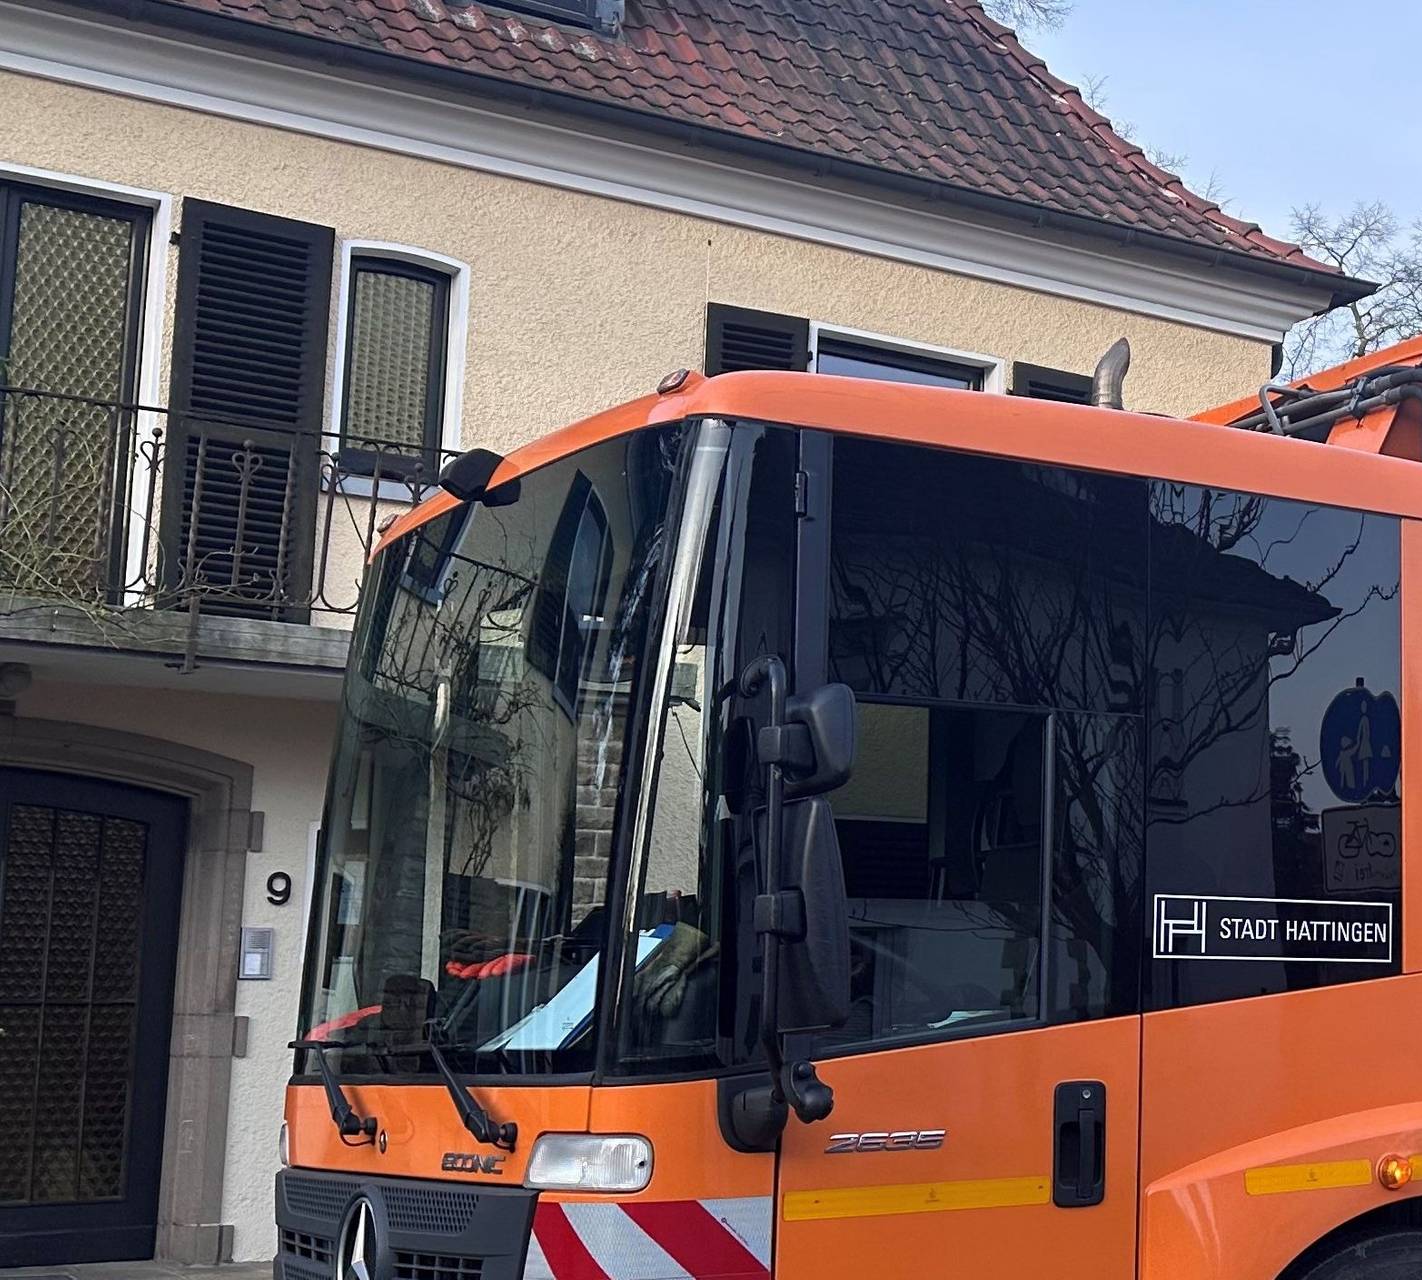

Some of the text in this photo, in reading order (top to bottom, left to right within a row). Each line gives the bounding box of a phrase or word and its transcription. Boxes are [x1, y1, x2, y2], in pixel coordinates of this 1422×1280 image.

[267, 871, 292, 906] 9
[1219, 917, 1279, 941] STADT
[1286, 919, 1387, 943] HATTINGEN
[824, 1130, 946, 1153] 2635
